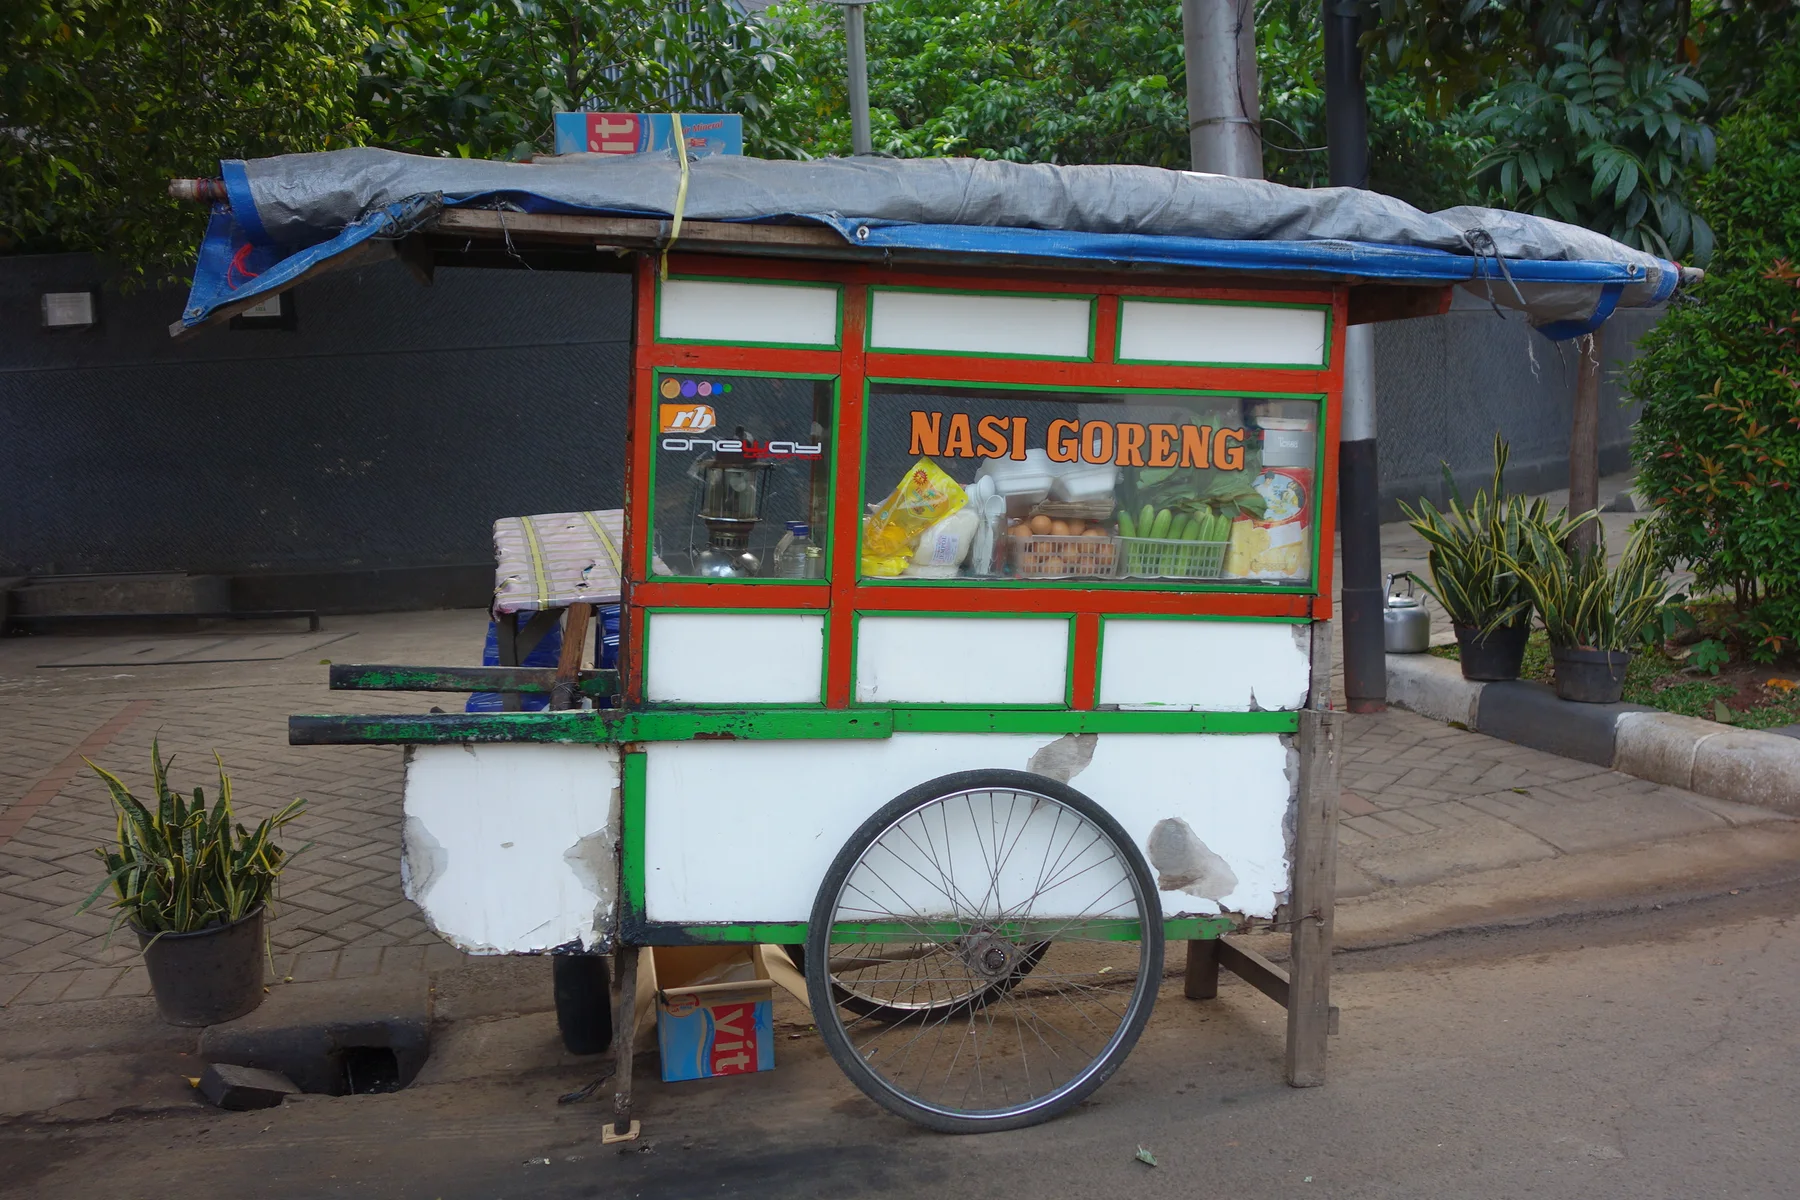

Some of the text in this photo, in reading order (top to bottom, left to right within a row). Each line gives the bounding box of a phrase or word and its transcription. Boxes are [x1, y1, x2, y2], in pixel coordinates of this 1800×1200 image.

[590, 117, 634, 151] it
[692, 119, 723, 133] Mineral
[671, 405, 712, 429] rb
[908, 410, 1245, 471] NASI GORENG
